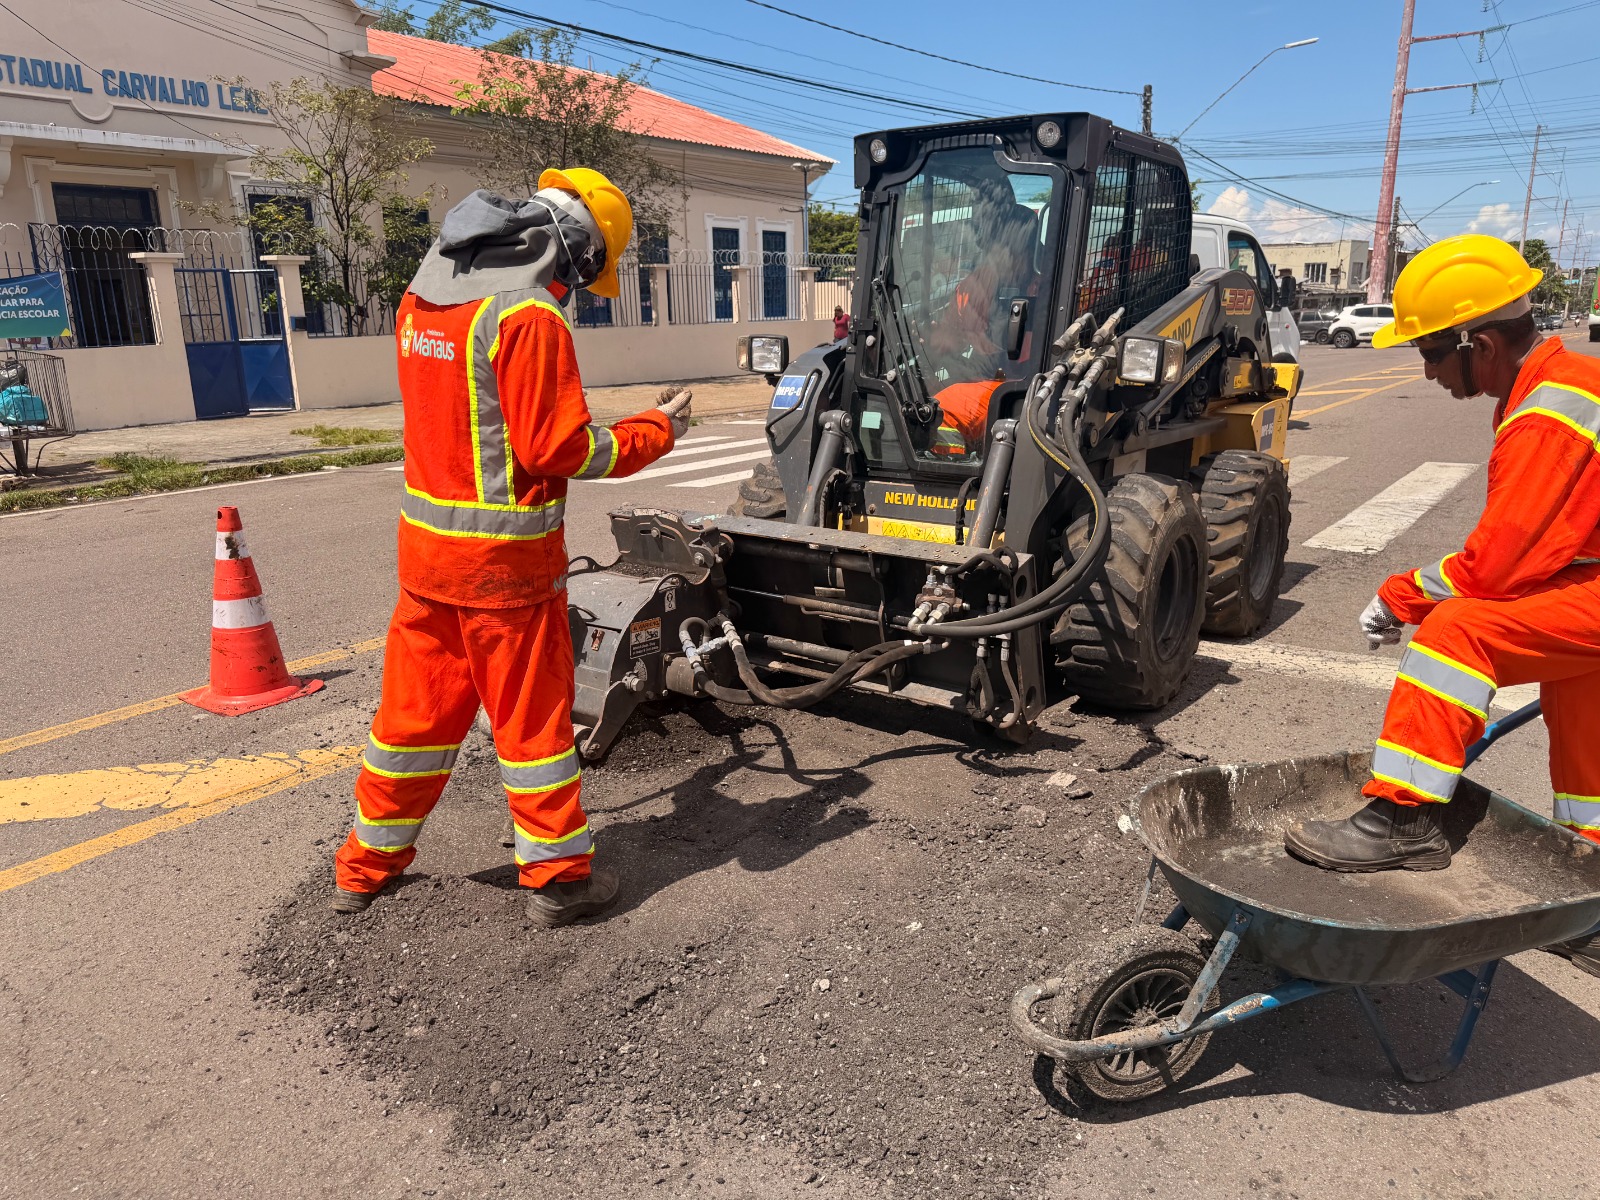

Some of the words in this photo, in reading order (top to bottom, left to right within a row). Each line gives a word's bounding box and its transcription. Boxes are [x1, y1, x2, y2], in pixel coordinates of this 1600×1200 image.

[0, 54, 93, 94] TADUAL
[101, 69, 210, 107] CARVALHO
[0, 285, 28, 296] AÇÃO
[20, 298, 44, 307] PARA
[0, 311, 17, 319] CIA
[18, 309, 60, 318] ESCOLAR
[1167, 317, 1191, 341] AND
[412, 330, 455, 361] Manaus
[885, 491, 915, 506] NEW
